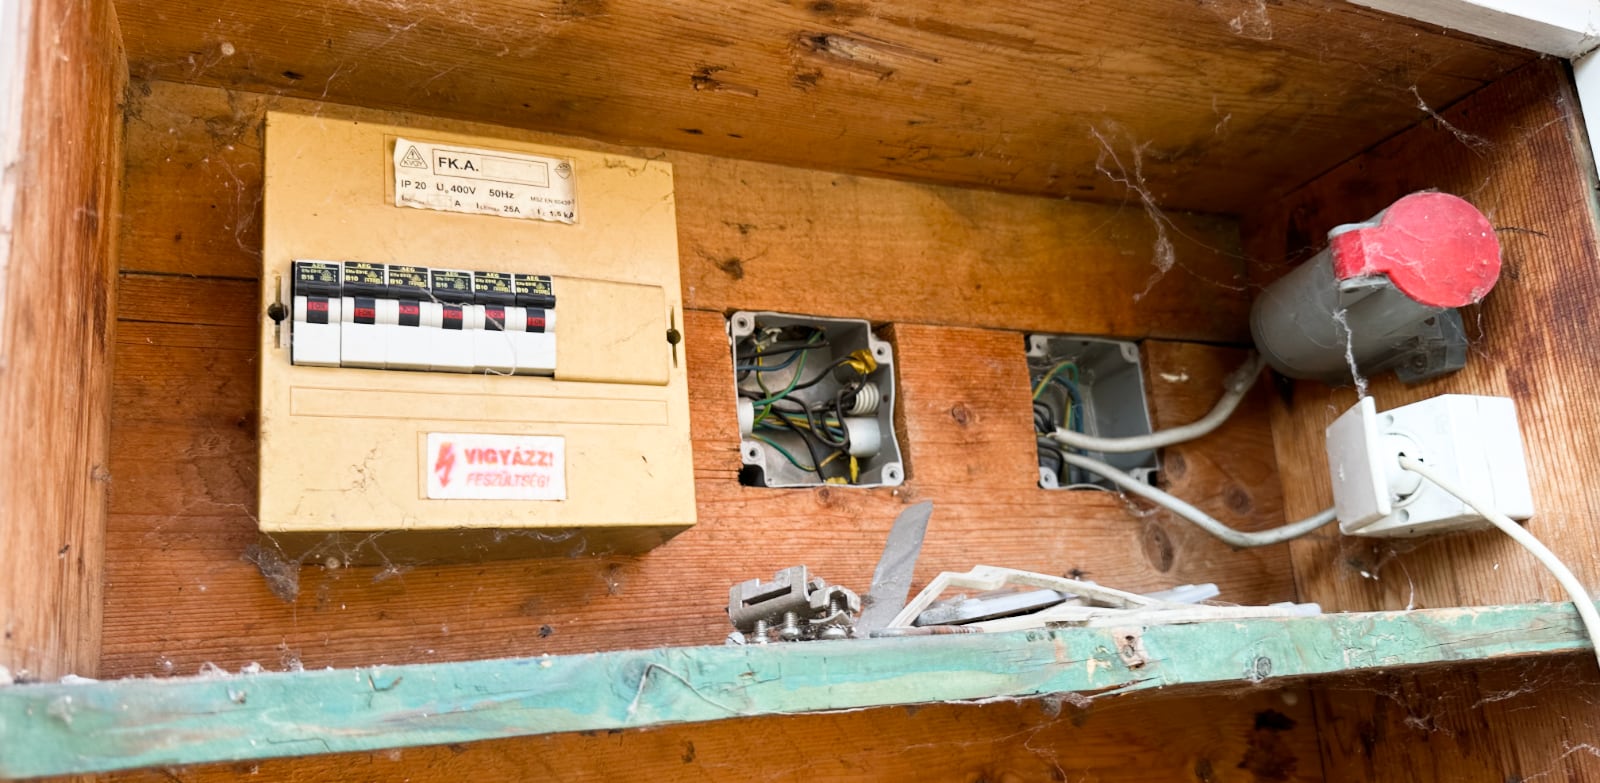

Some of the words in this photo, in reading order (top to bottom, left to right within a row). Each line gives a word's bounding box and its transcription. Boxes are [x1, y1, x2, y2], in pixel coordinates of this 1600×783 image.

[438, 157, 479, 172] FK.A.
[401, 180, 411, 188] IP
[415, 181, 426, 190] 20
[450, 185, 476, 194] 400V
[489, 188, 514, 199] 50Hz
[504, 205, 520, 214] 25A
[464, 446, 554, 466] VIGYÁZZ!
[466, 471, 550, 488] FESZÜLTSÉG!
